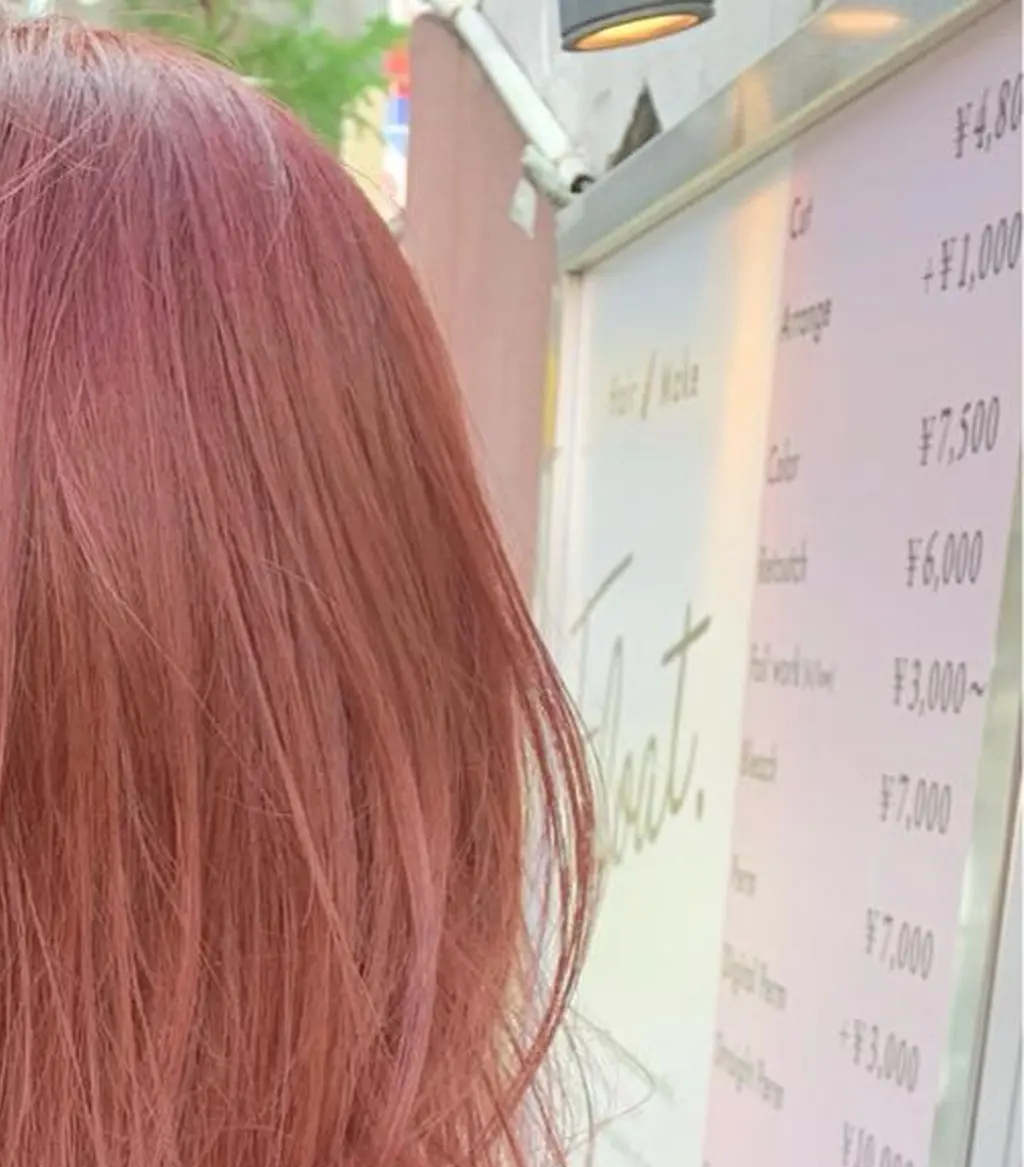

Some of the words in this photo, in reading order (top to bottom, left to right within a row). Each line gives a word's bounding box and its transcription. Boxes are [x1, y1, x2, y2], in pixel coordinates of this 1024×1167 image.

[919, 396, 1000, 467] ¥7,500
[906, 529, 983, 592] ¥6,000
[880, 773, 952, 835] ¥7,000
[864, 907, 935, 980] ¥7,000
